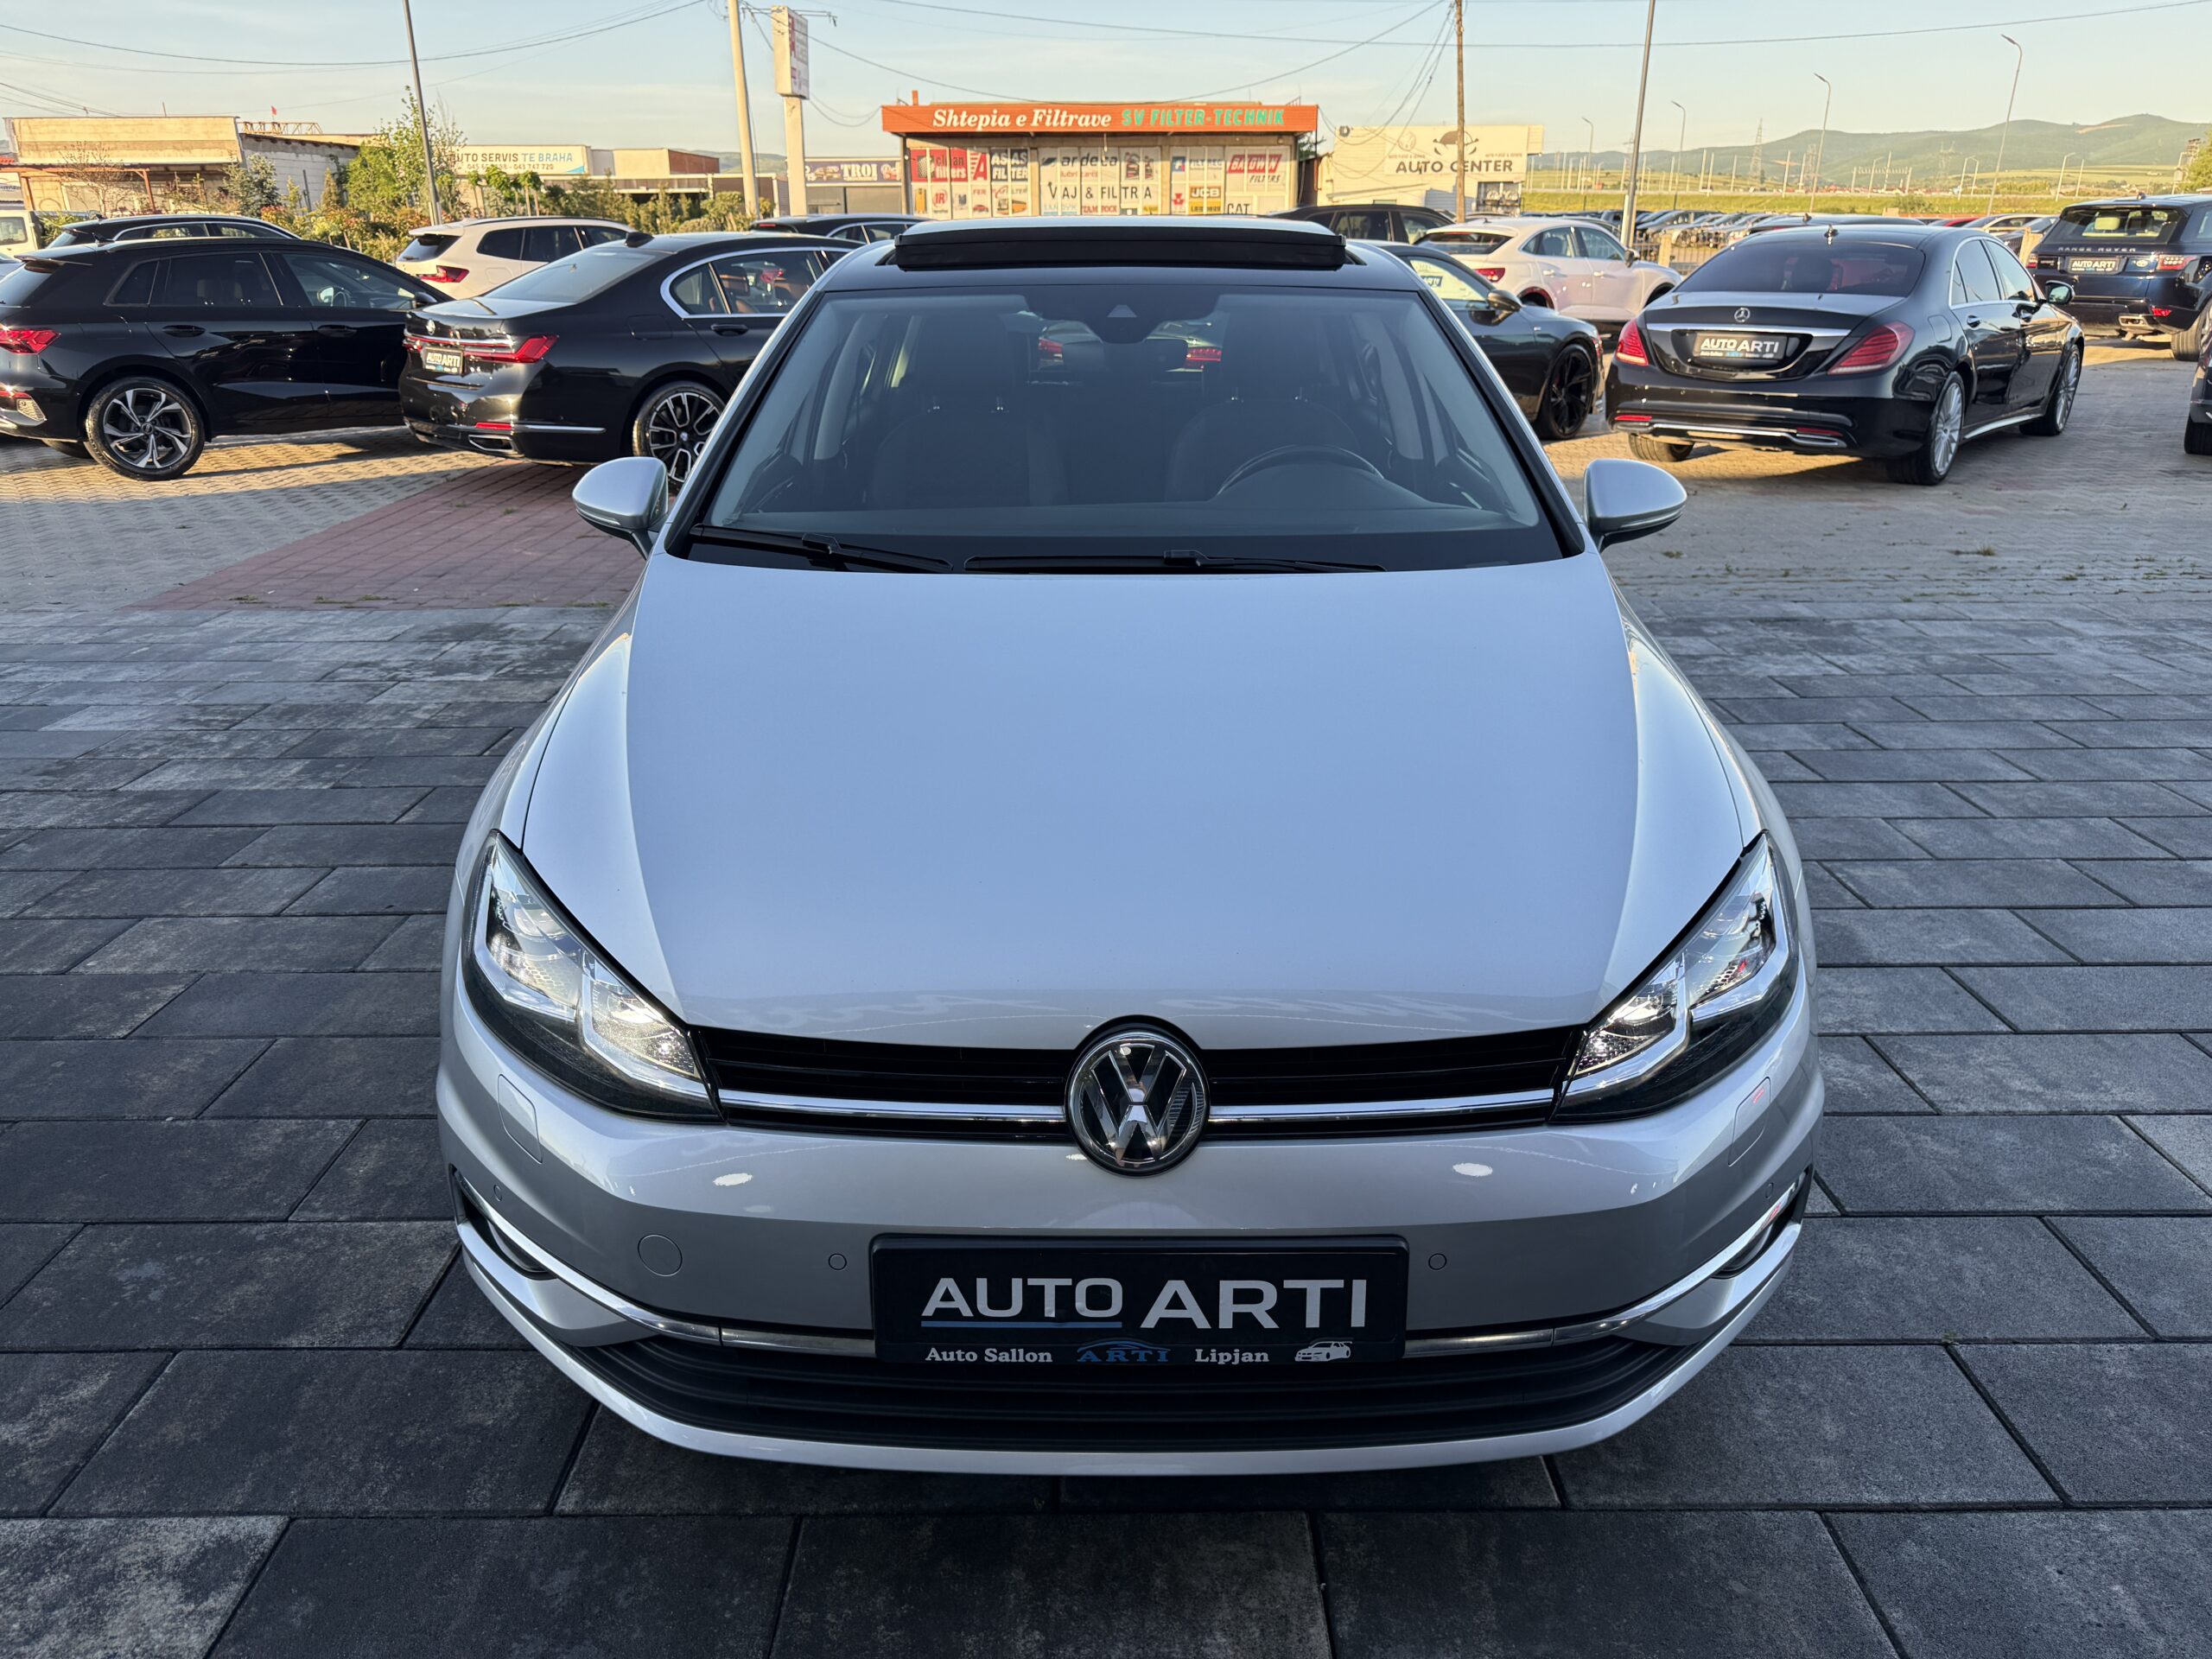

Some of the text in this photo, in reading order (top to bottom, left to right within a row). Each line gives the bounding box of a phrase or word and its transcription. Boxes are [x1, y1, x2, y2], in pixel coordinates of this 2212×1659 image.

[932, 108, 1112, 130] Shtepia e Filtrave
[1122, 109, 1146, 126] SV
[481, 153, 518, 162] SERVIS
[521, 153, 536, 162] TE
[538, 153, 573, 162] BRAHA
[1395, 161, 1444, 174] AUTO
[1048, 185, 1077, 199] VAJ
[1085, 187, 1094, 200] &
[1191, 188, 1220, 197] JCB
[1227, 203, 1251, 214] CAT
[1700, 338, 1780, 353] AUTO ARTI
[921, 1277, 1367, 1329] AUTO ARTI
[925, 1347, 1269, 1365] Auto Sallon ARTI Lipjan
